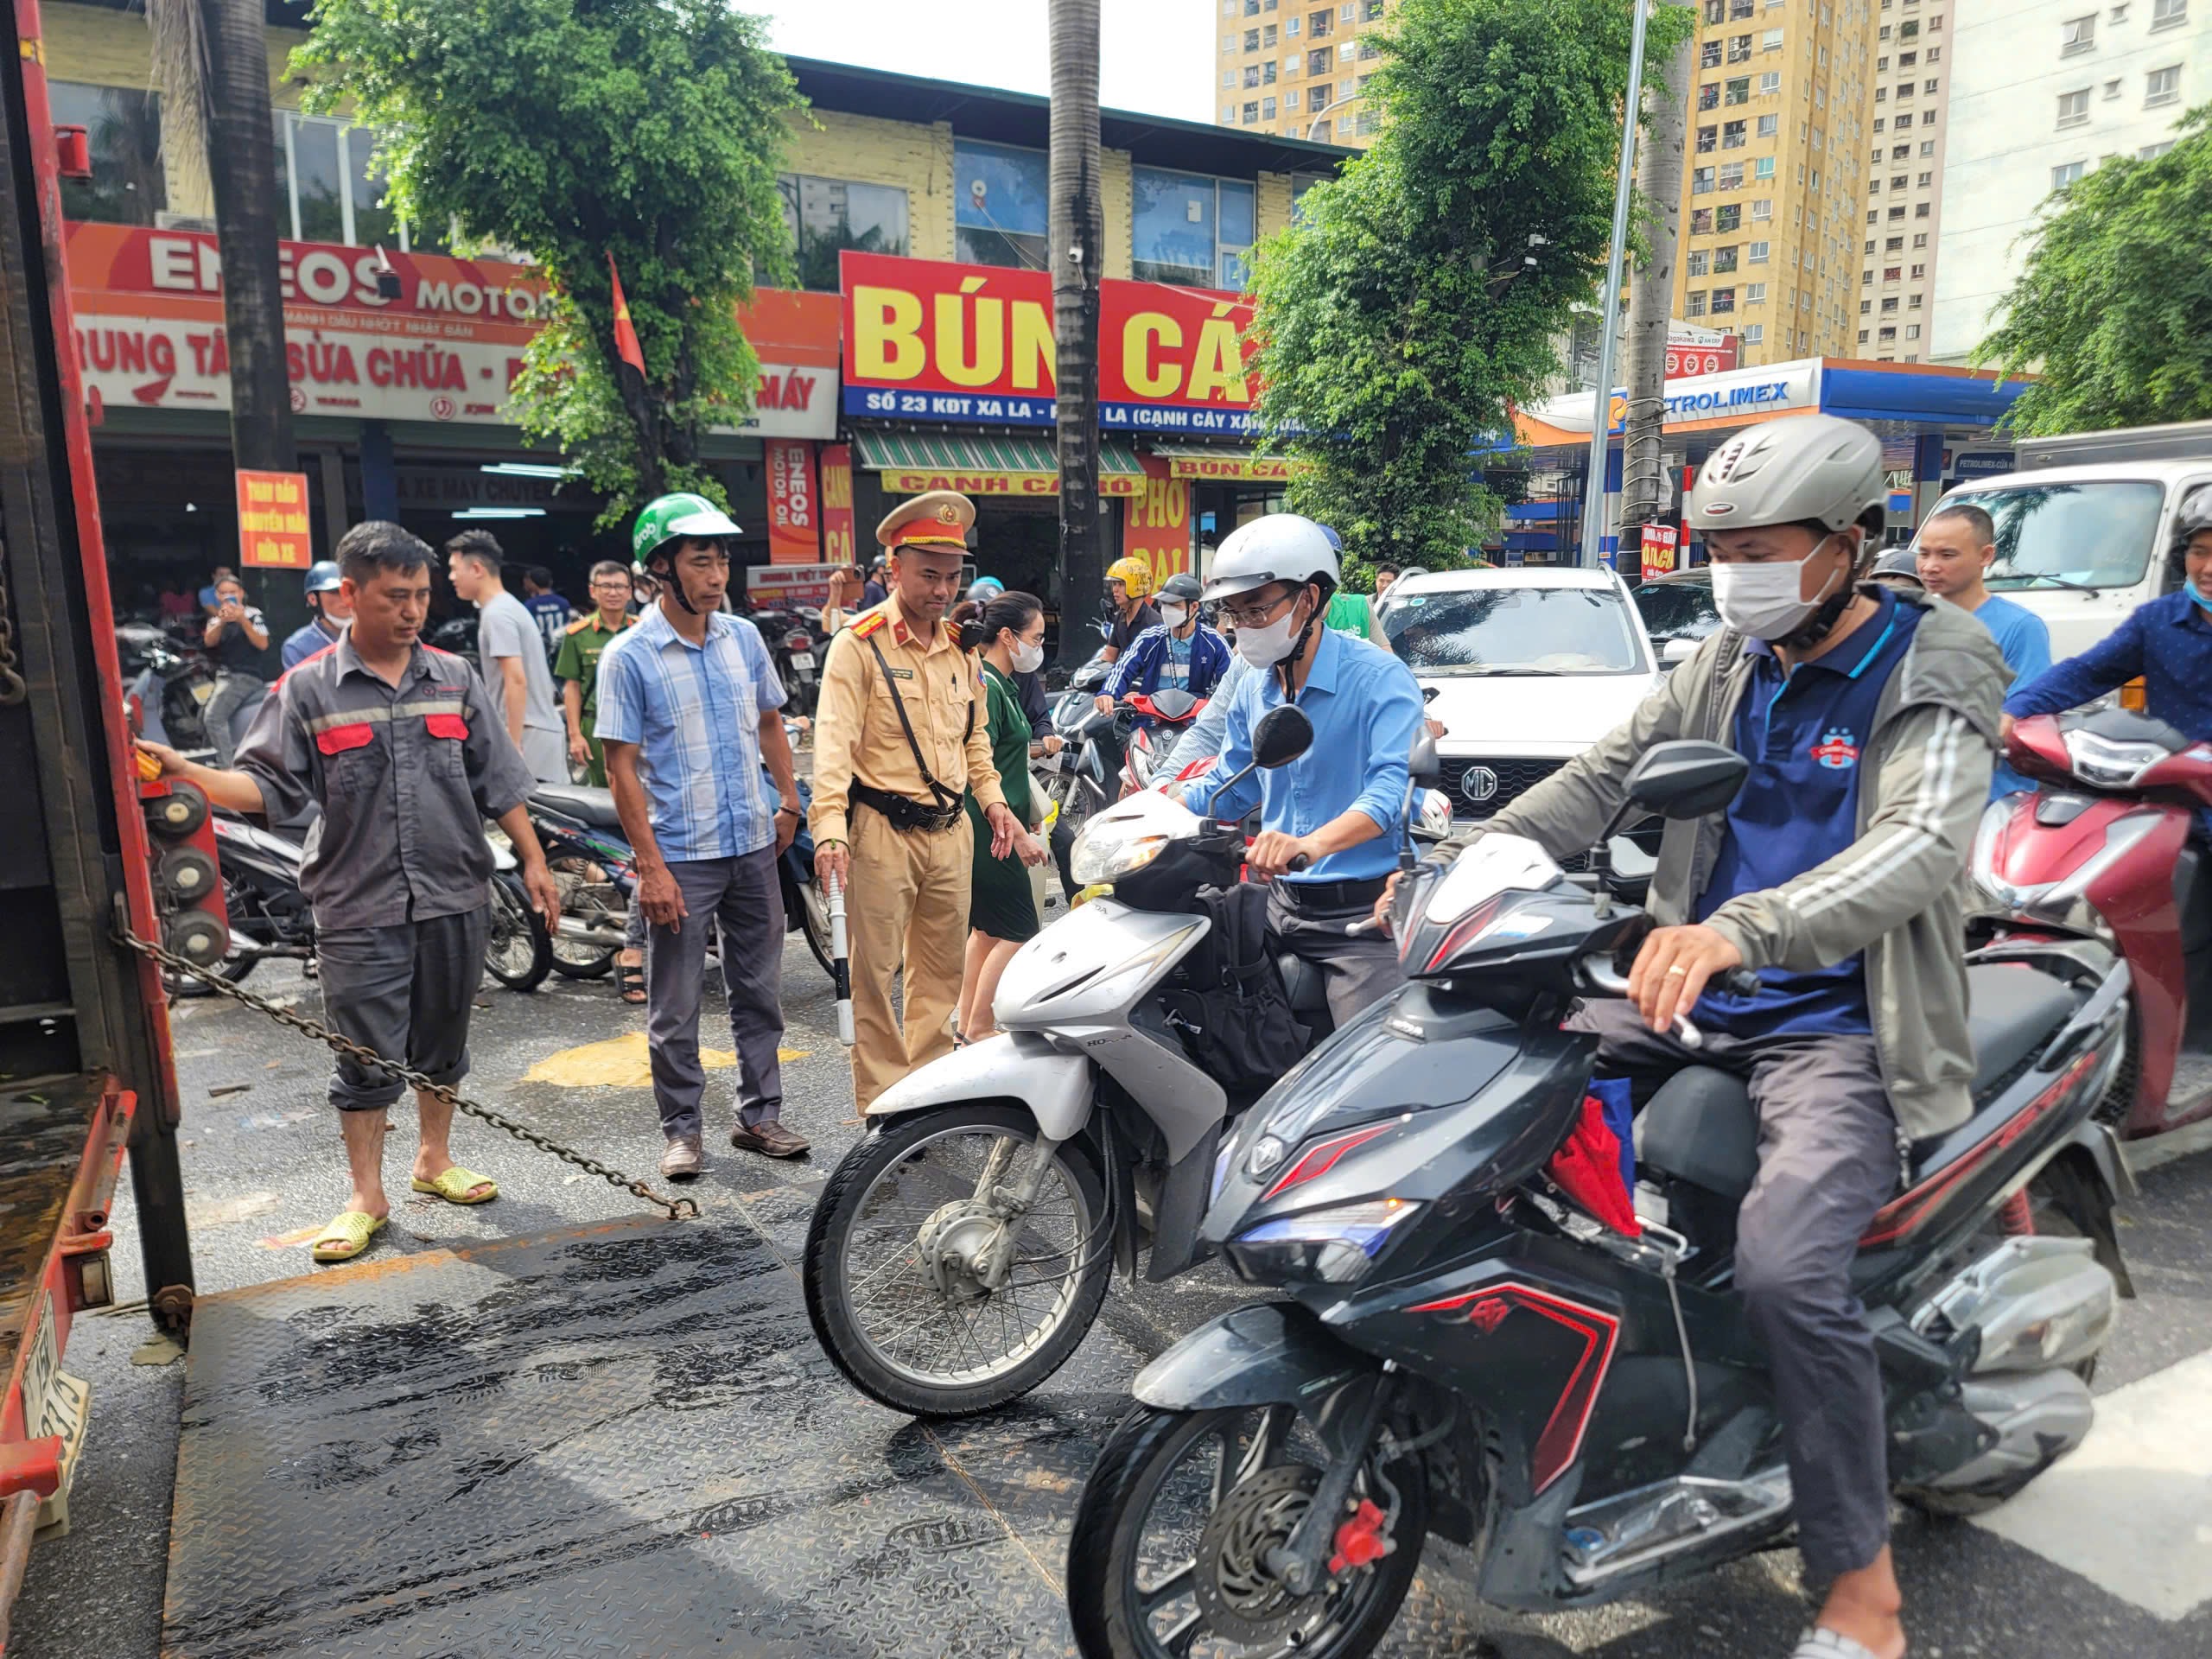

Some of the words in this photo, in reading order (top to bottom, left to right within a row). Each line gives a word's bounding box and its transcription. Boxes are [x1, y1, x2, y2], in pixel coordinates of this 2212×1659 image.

[853, 276, 1057, 389] BÚN
[1122, 303, 1249, 403] CÁ
[186, 327, 231, 378] TÂ
[366, 344, 467, 391] CHỮA
[755, 366, 817, 411] MÁY
[1663, 381, 1789, 414] TROLIMEX
[866, 390, 896, 411] SỐ
[901, 396, 927, 413] 23
[932, 397, 972, 416] KĐT
[976, 400, 1002, 417] XA
[1007, 402, 1032, 418] LA
[1105, 407, 1127, 423] LA
[1192, 410, 1226, 429] CÂY
[774, 448, 787, 499] MOTOR
[1178, 461, 1241, 475] BÚN
[788, 448, 810, 526] ENEOS
[899, 475, 1009, 493] CANH
[775, 505, 788, 526] OIL
[633, 523, 657, 550] Grab
[826, 521, 853, 566] CÁ
[1465, 769, 1494, 798] MG
[1087, 1034, 1133, 1047] HOA
